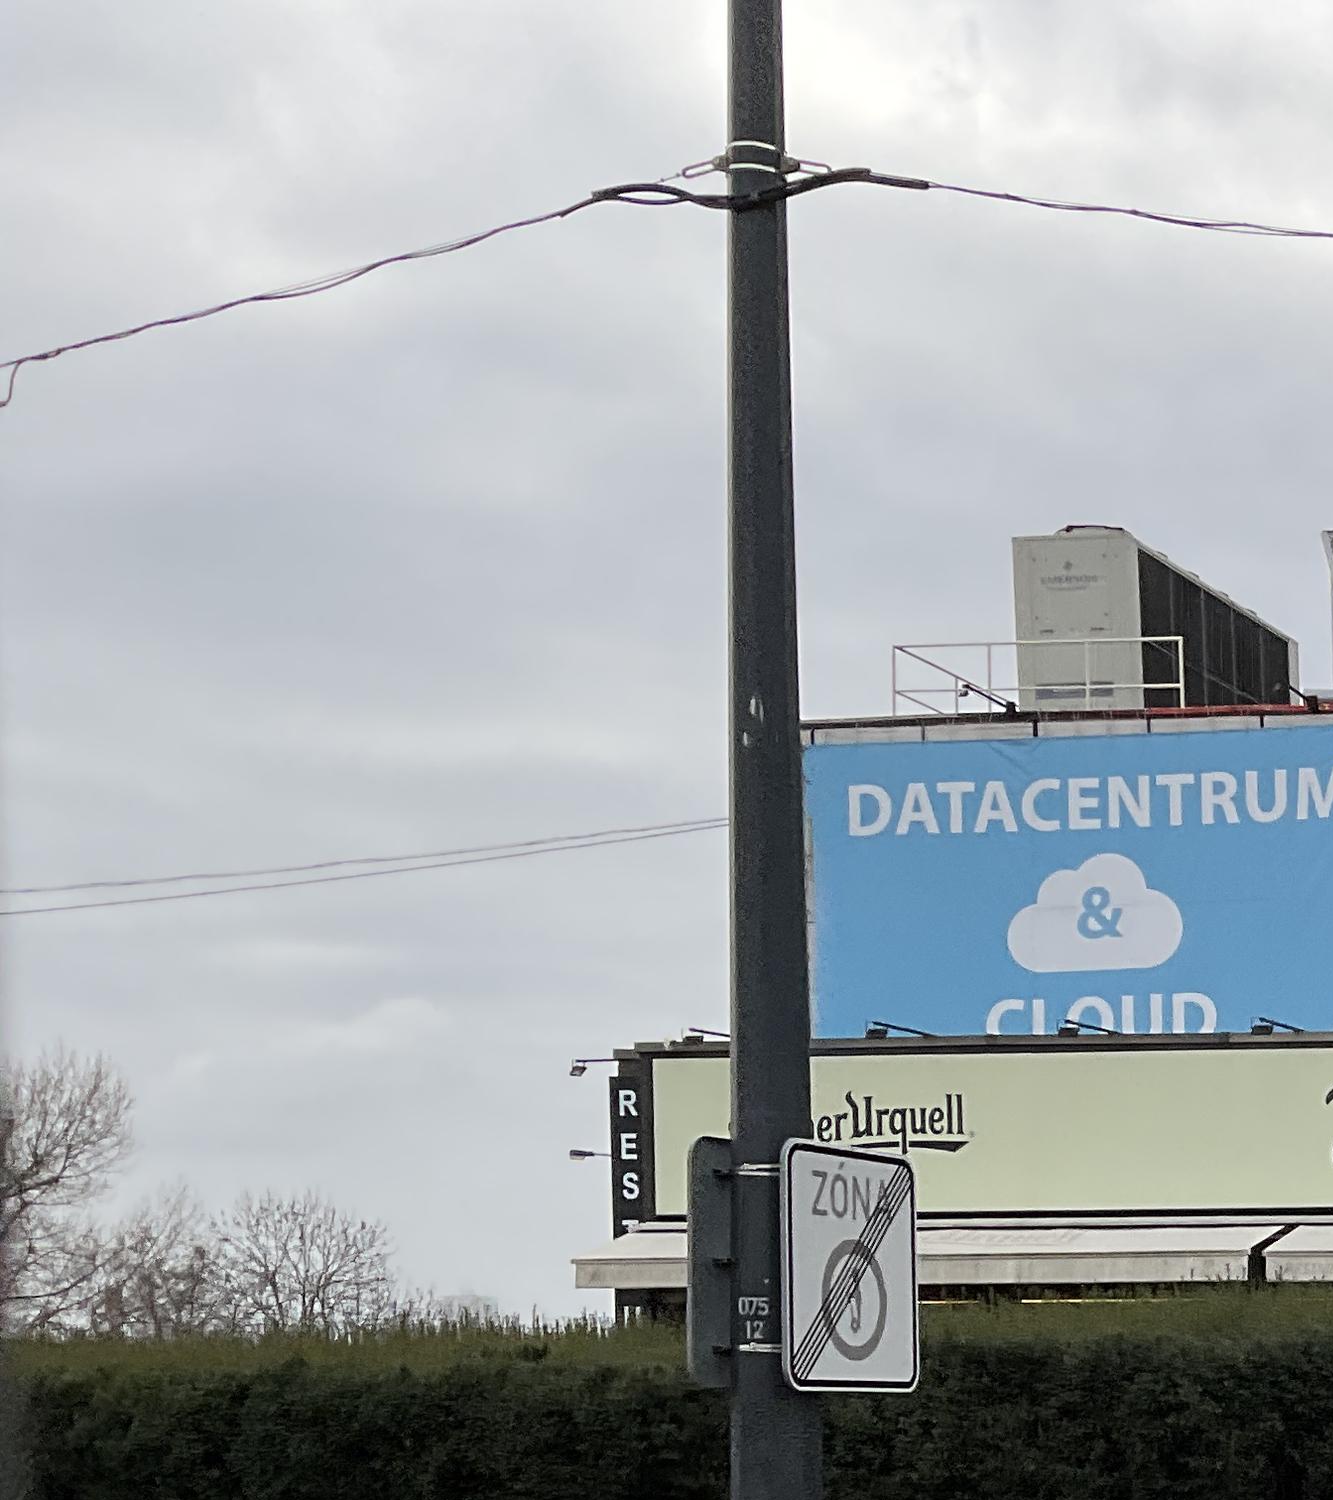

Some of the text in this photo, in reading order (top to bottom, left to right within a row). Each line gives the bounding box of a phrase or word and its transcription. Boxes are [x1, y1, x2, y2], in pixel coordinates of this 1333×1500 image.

[1076, 886, 1123, 939] &
[845, 1090, 965, 1155] Urquell
[738, 1297, 770, 1316] 075
[746, 1320, 764, 1339] 12
